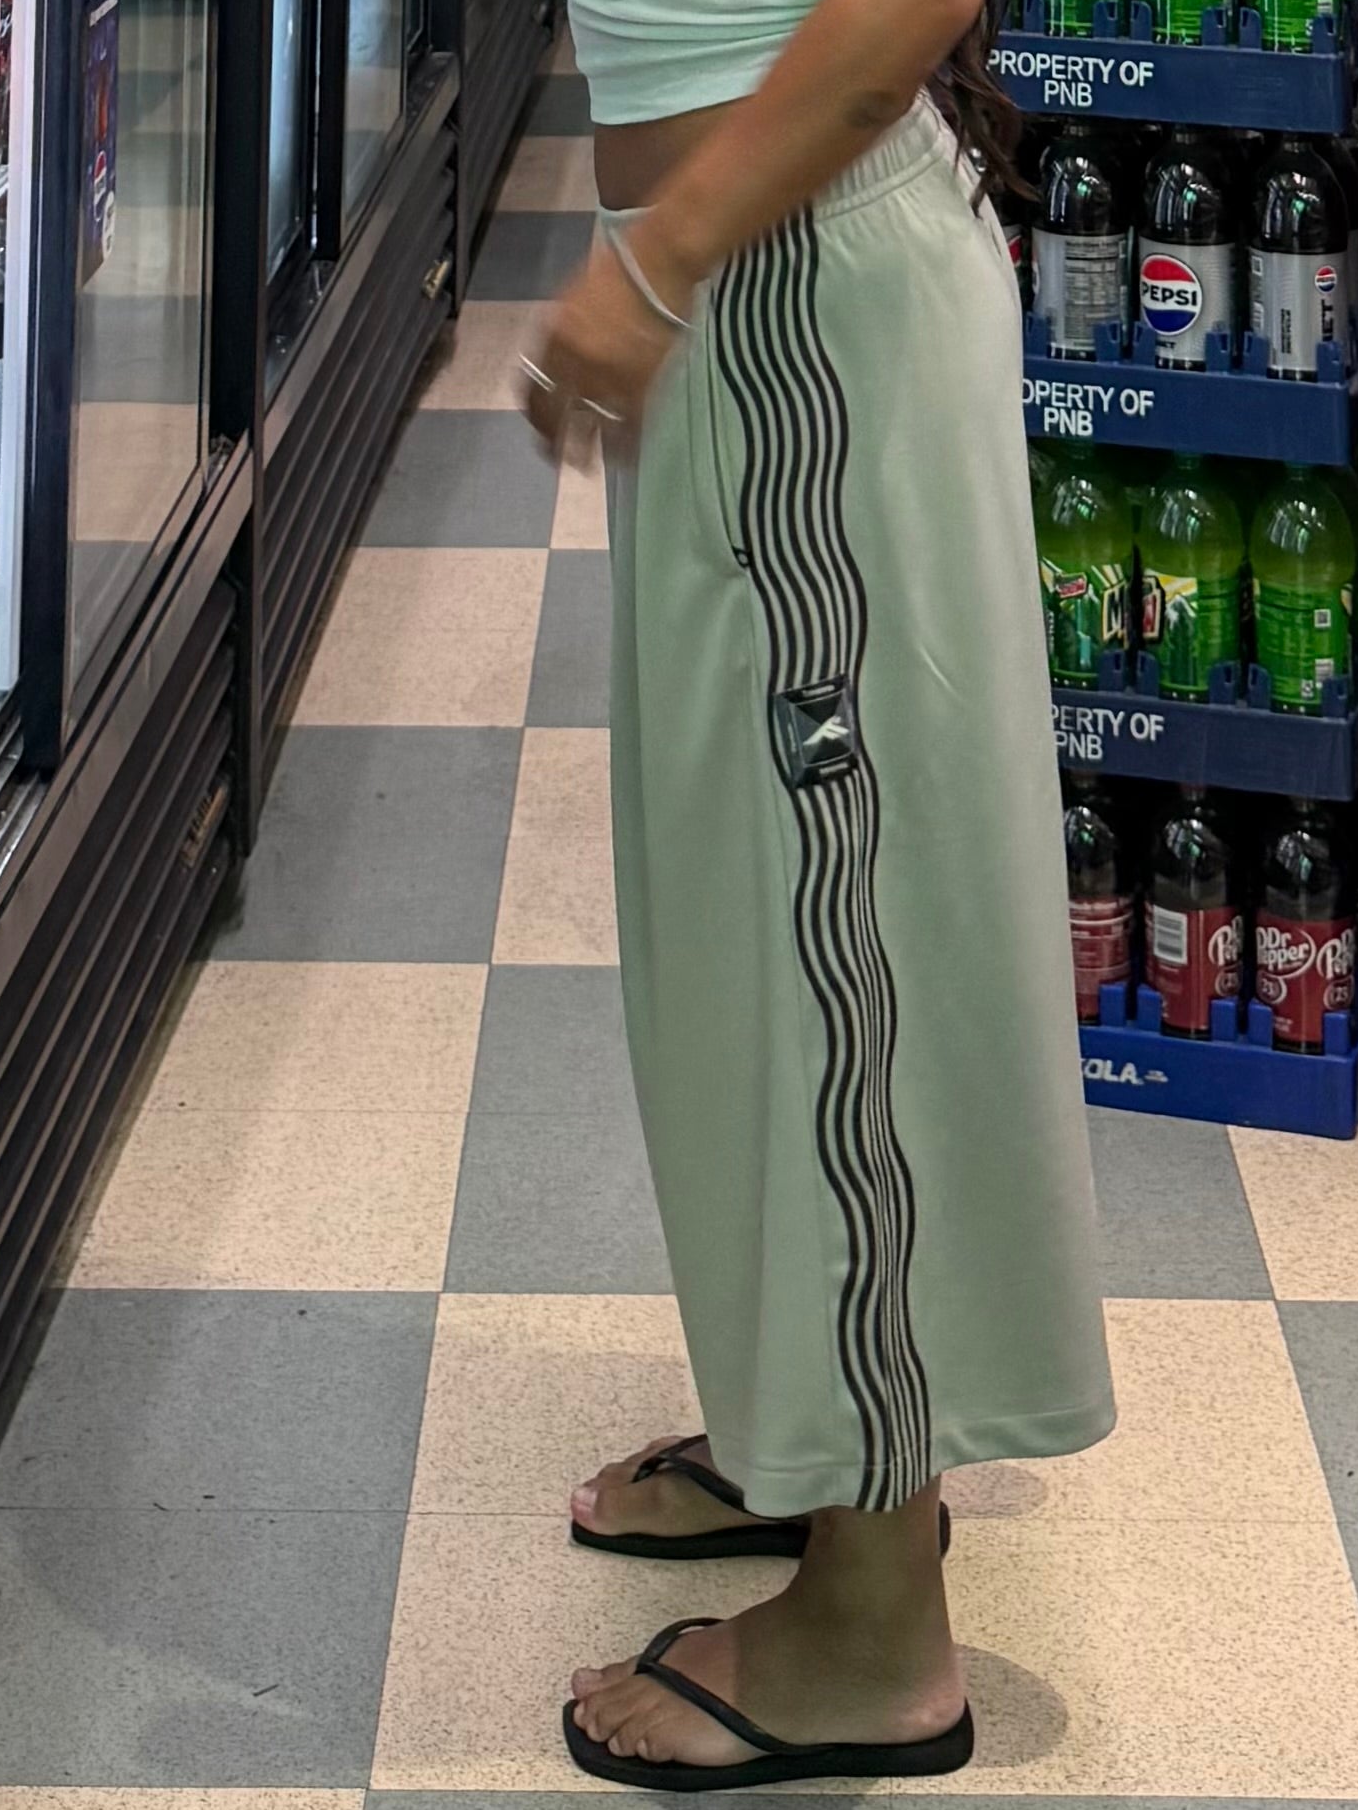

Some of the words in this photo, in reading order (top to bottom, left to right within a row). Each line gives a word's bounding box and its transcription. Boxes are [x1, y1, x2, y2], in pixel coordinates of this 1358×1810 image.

[986, 49, 1114, 83] PROPERTY
[1119, 59, 1154, 86] OF
[1043, 81, 1092, 107] PNB
[1142, 284, 1198, 308] PEPSI
[1121, 389, 1154, 415] OF
[1043, 409, 1092, 436] PNB
[1130, 713, 1164, 742] OF
